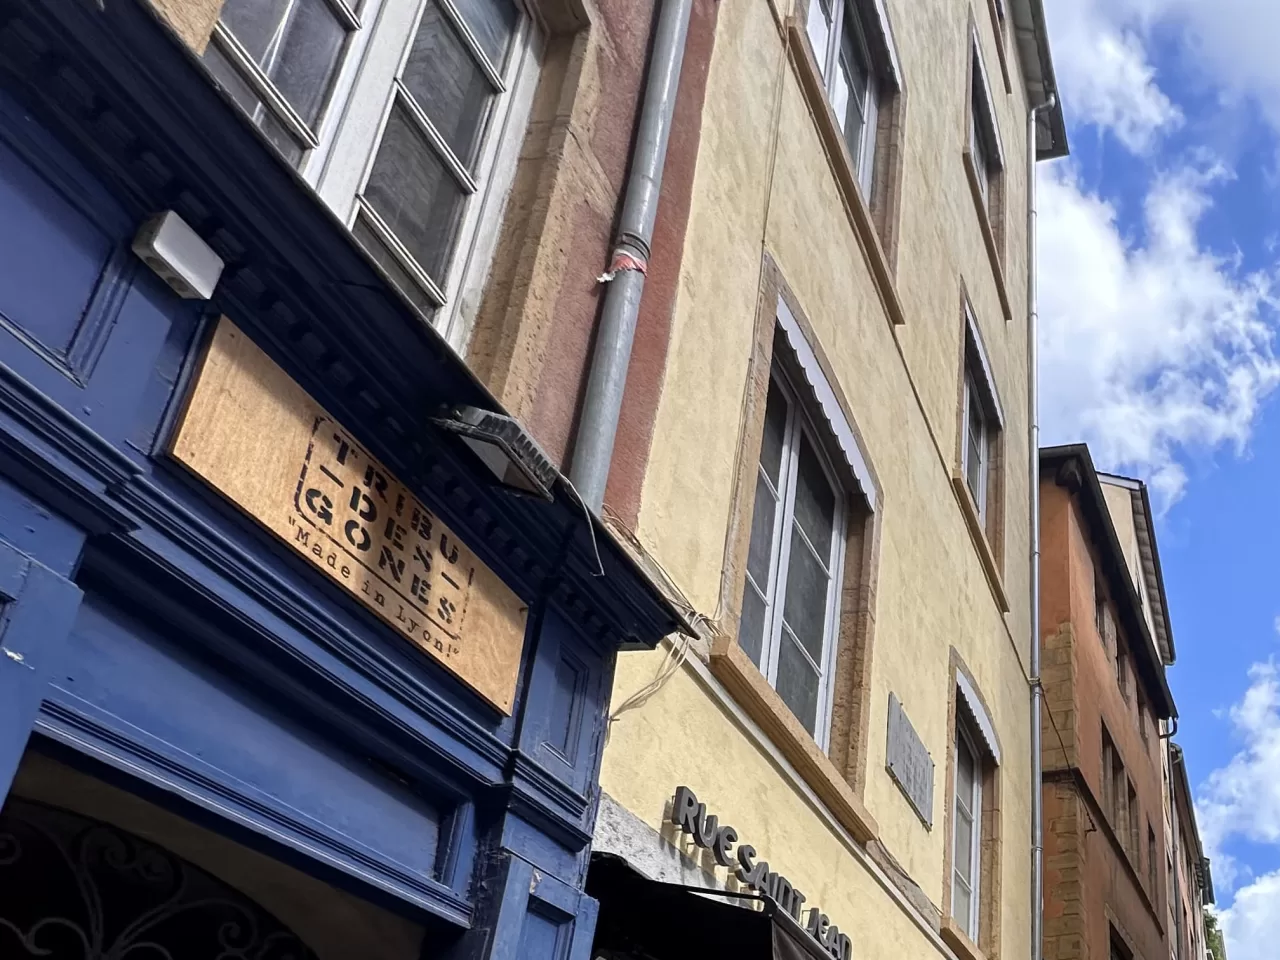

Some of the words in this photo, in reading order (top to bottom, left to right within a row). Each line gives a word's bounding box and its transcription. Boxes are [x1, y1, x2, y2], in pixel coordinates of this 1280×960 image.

[305, 487, 456, 625] GONES
[332, 432, 460, 566] TRIBU
[349, 485, 433, 573] DES
[361, 579, 386, 608] in
[672, 785, 739, 867] RUE
[734, 844, 807, 926] SAINT
